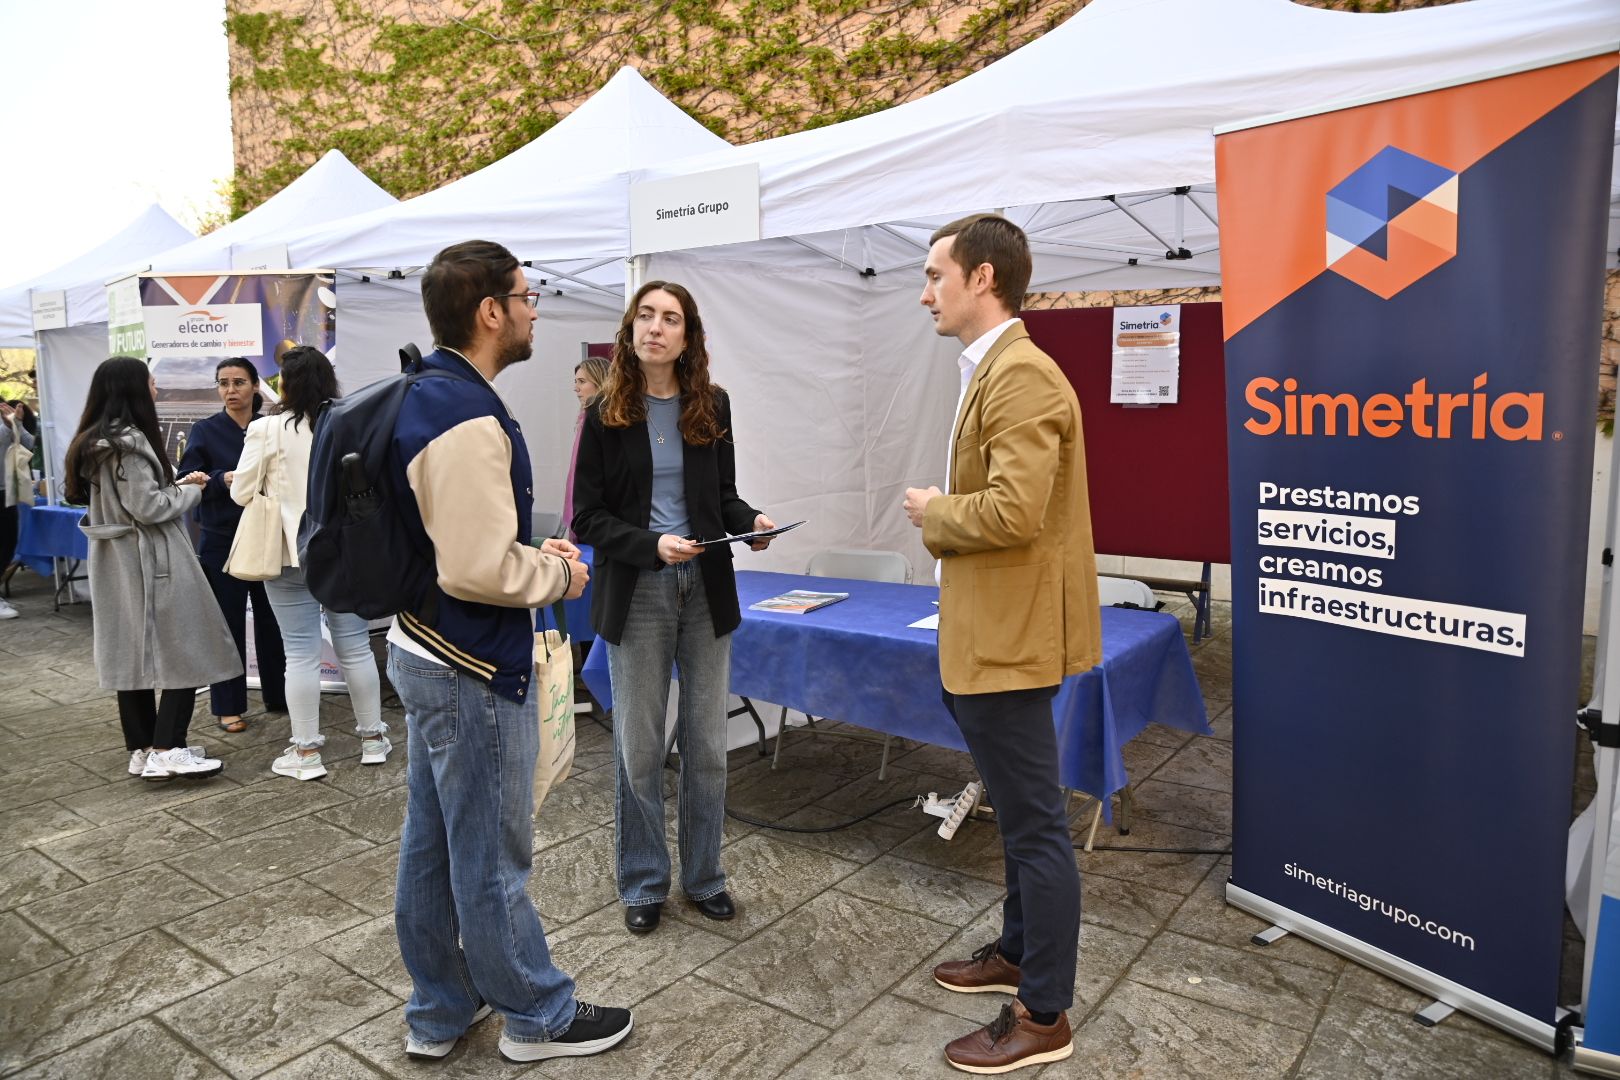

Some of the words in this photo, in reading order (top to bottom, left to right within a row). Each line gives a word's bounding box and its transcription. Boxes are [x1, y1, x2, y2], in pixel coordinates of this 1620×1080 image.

[698, 201, 729, 214] Grupo
[178, 321, 228, 333] elecnor
[151, 340, 189, 349] Generadores
[191, 340, 198, 348] de
[200, 339, 222, 348] cambio
[1244, 372, 1544, 441] Simetría
[1259, 482, 1420, 515] Prestamos
[1259, 519, 1394, 555] servicios,
[1259, 556, 1383, 587] creamos
[1260, 583, 1524, 648] infraestructuras.
[1284, 863, 1475, 951] simetriagrupo.com
